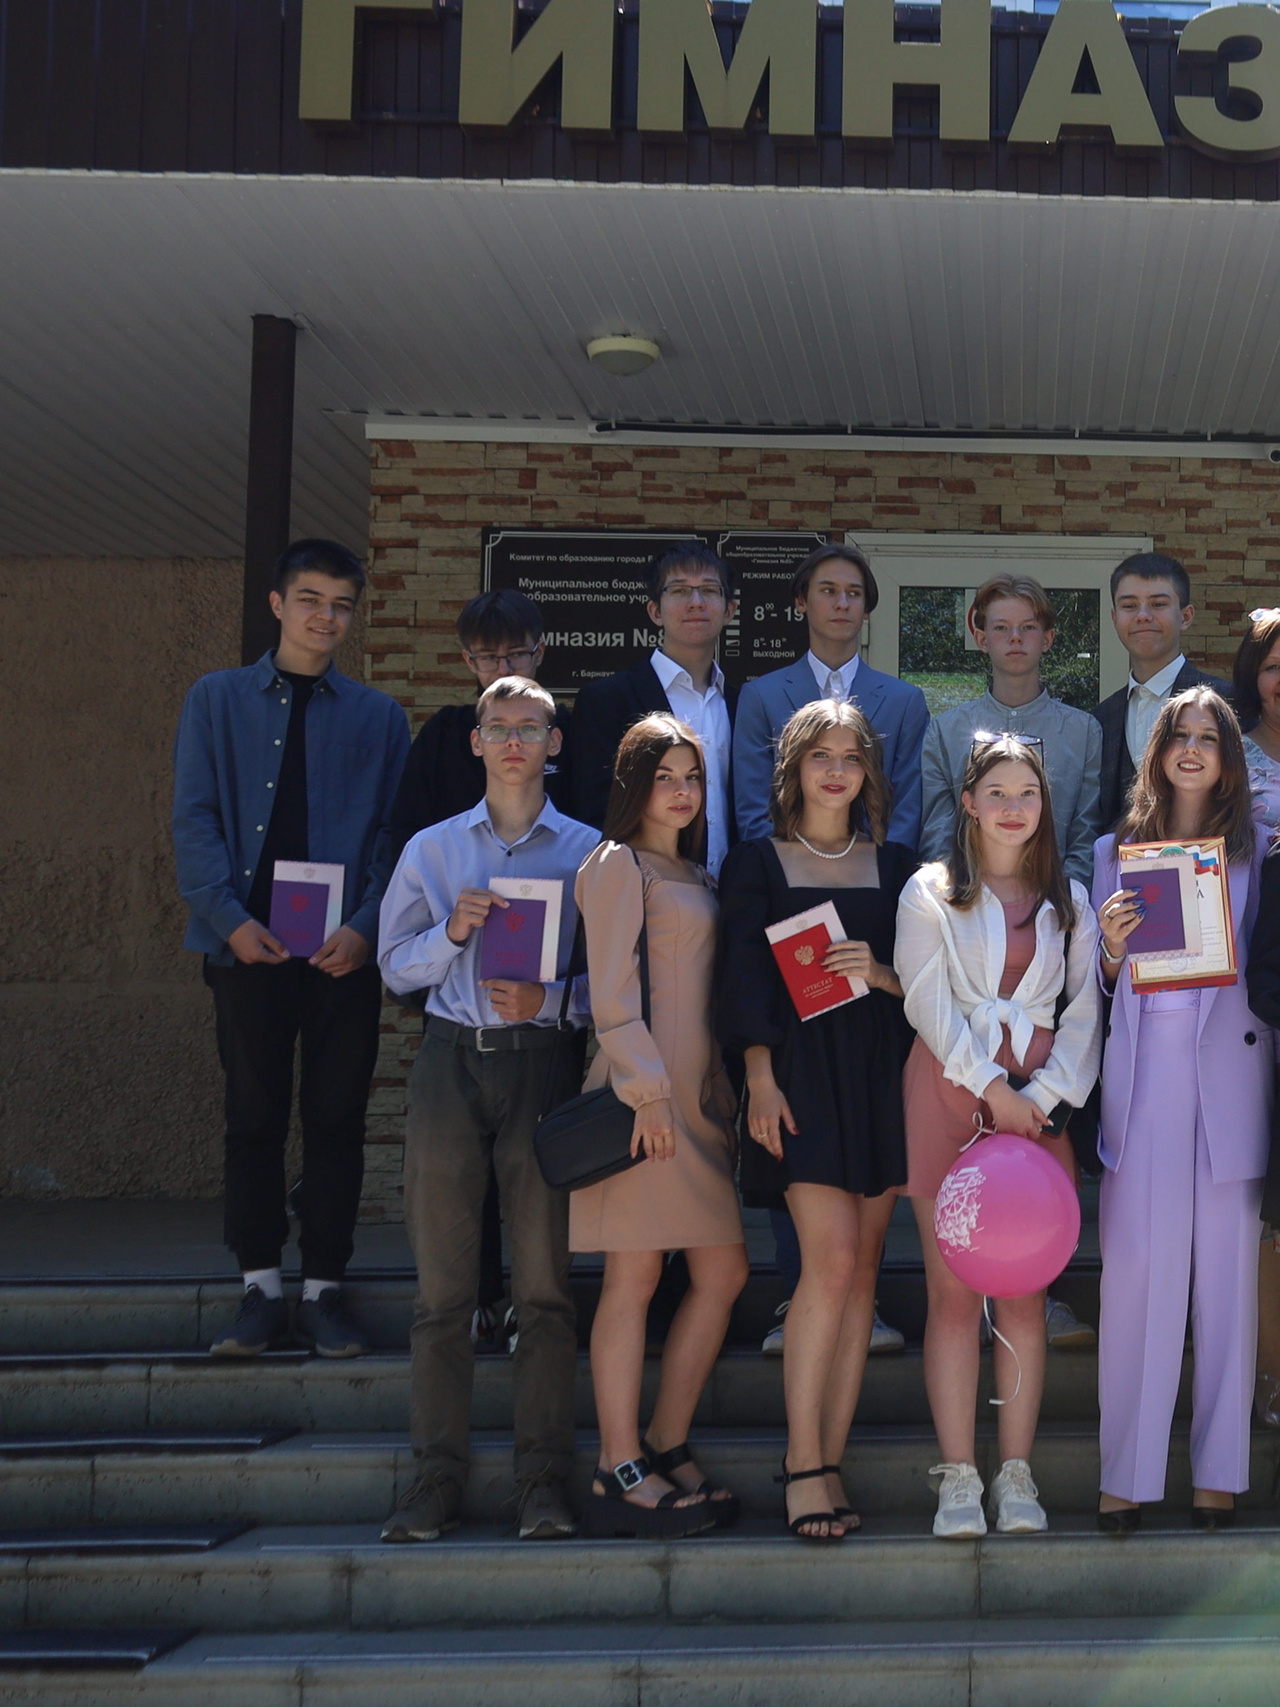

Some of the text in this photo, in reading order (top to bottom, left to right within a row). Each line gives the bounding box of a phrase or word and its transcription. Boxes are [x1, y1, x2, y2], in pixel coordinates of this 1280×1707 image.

[509, 553, 545, 562] Комитет
[558, 554, 615, 564] образованию
[616, 556, 646, 564] города
[742, 572, 796, 580] РЕЖИМ РАБОТ
[518, 577, 648, 591] Муниципальное бюдж
[522, 591, 649, 604] образовательное учр
[541, 628, 665, 648] мназия №8
[752, 650, 796, 659] ВЫХОДНОЙ
[802, 977, 834, 994] АТТЕСТАТ
